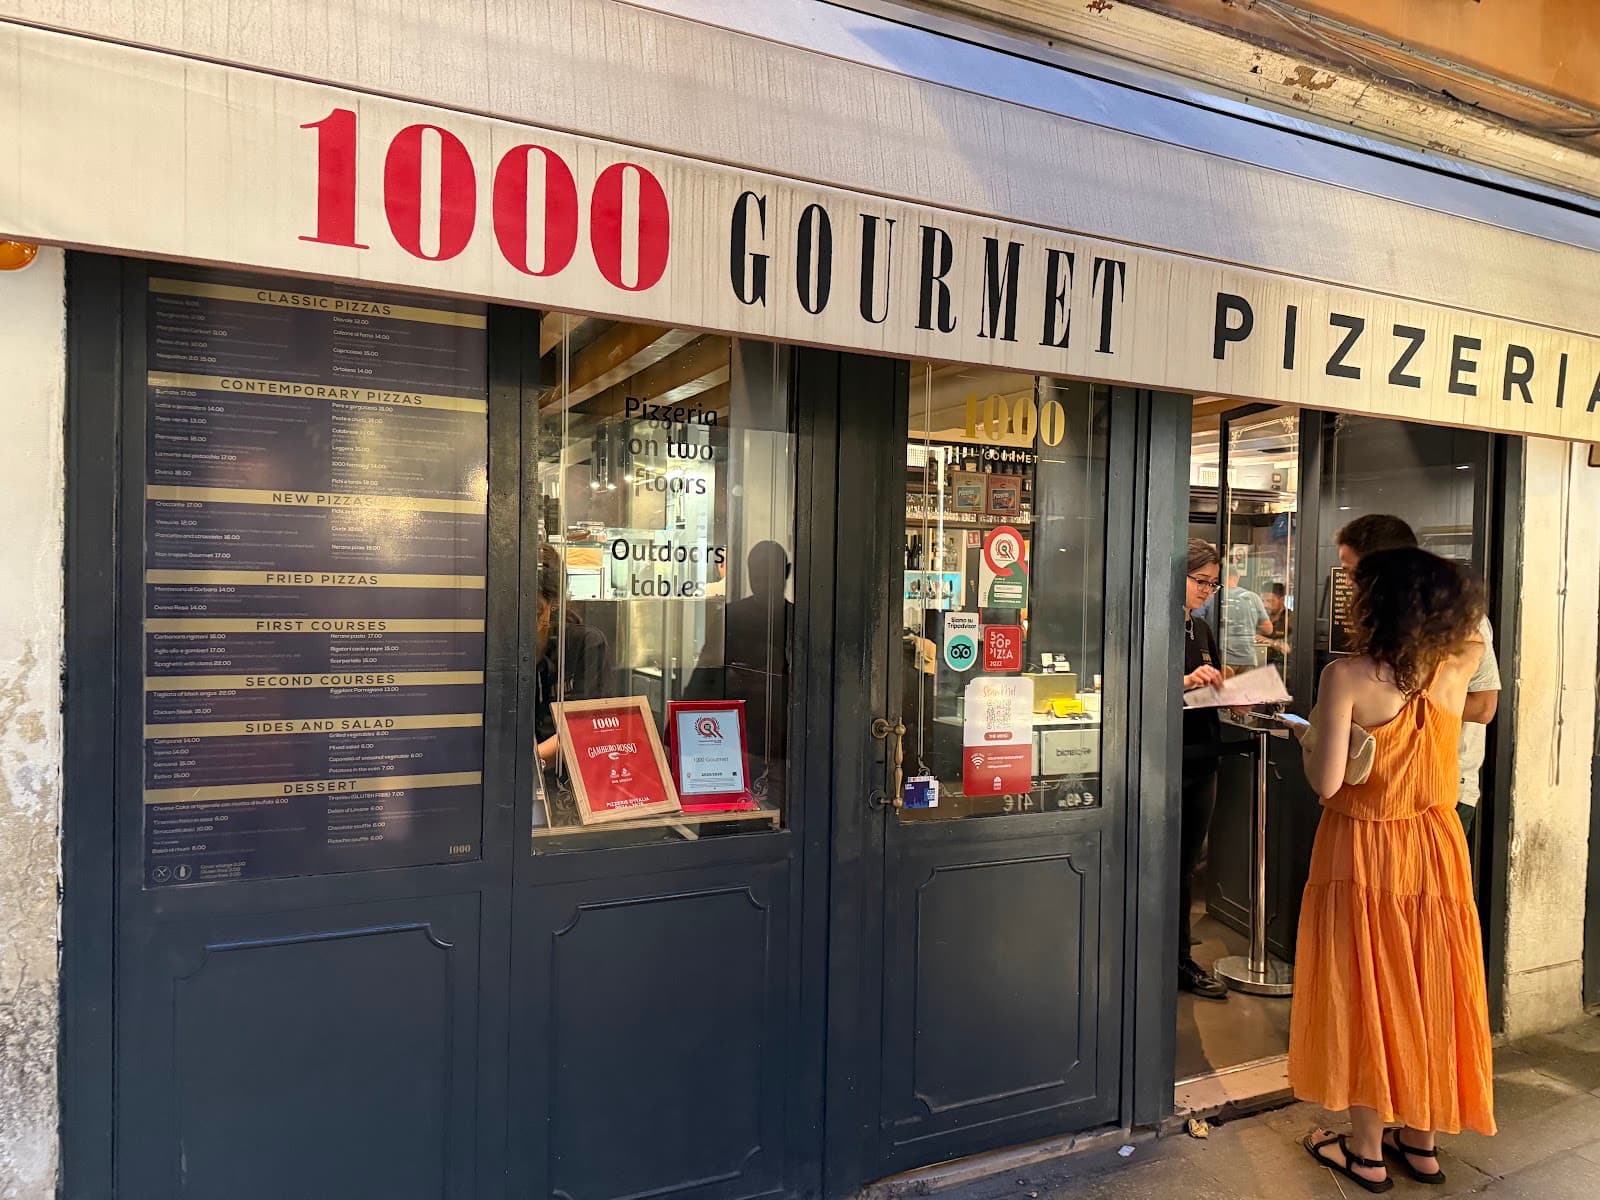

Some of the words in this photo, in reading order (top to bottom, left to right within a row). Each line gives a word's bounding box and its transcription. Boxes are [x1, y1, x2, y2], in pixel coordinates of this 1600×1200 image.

[298, 108, 670, 292] 1000
[730, 191, 1125, 354] GOURMET
[256, 291, 329, 308] CLASSIC
[335, 300, 391, 315] PIZZAS
[221, 379, 360, 399] CONTEMPORARY
[367, 392, 422, 405] PIZZAS
[625, 397, 718, 426] Pizzeria
[960, 393, 1065, 447] 1000
[628, 438, 658, 455] on
[667, 436, 713, 460] two
[984, 451, 1038, 464] GOURMET
[635, 468, 706, 497] floors
[272, 493, 309, 504] NEW
[316, 495, 372, 506] PIZZAS
[611, 538, 725, 564] Outdoors
[266, 574, 314, 584] FRIED
[321, 575, 378, 585] PIZZAS
[631, 574, 706, 597] tables
[256, 621, 304, 631] FIRST
[311, 621, 387, 631] COURSES
[990, 639, 1011, 648] TOP
[245, 677, 313, 687] SECOND
[320, 675, 396, 685] COURSES
[245, 722, 294, 733] SIDES
[301, 720, 334, 731] AND
[341, 719, 395, 730] SALAD
[592, 717, 619, 729] 1000
[283, 781, 357, 794] DESSERT
[449, 845, 471, 854] 1000
